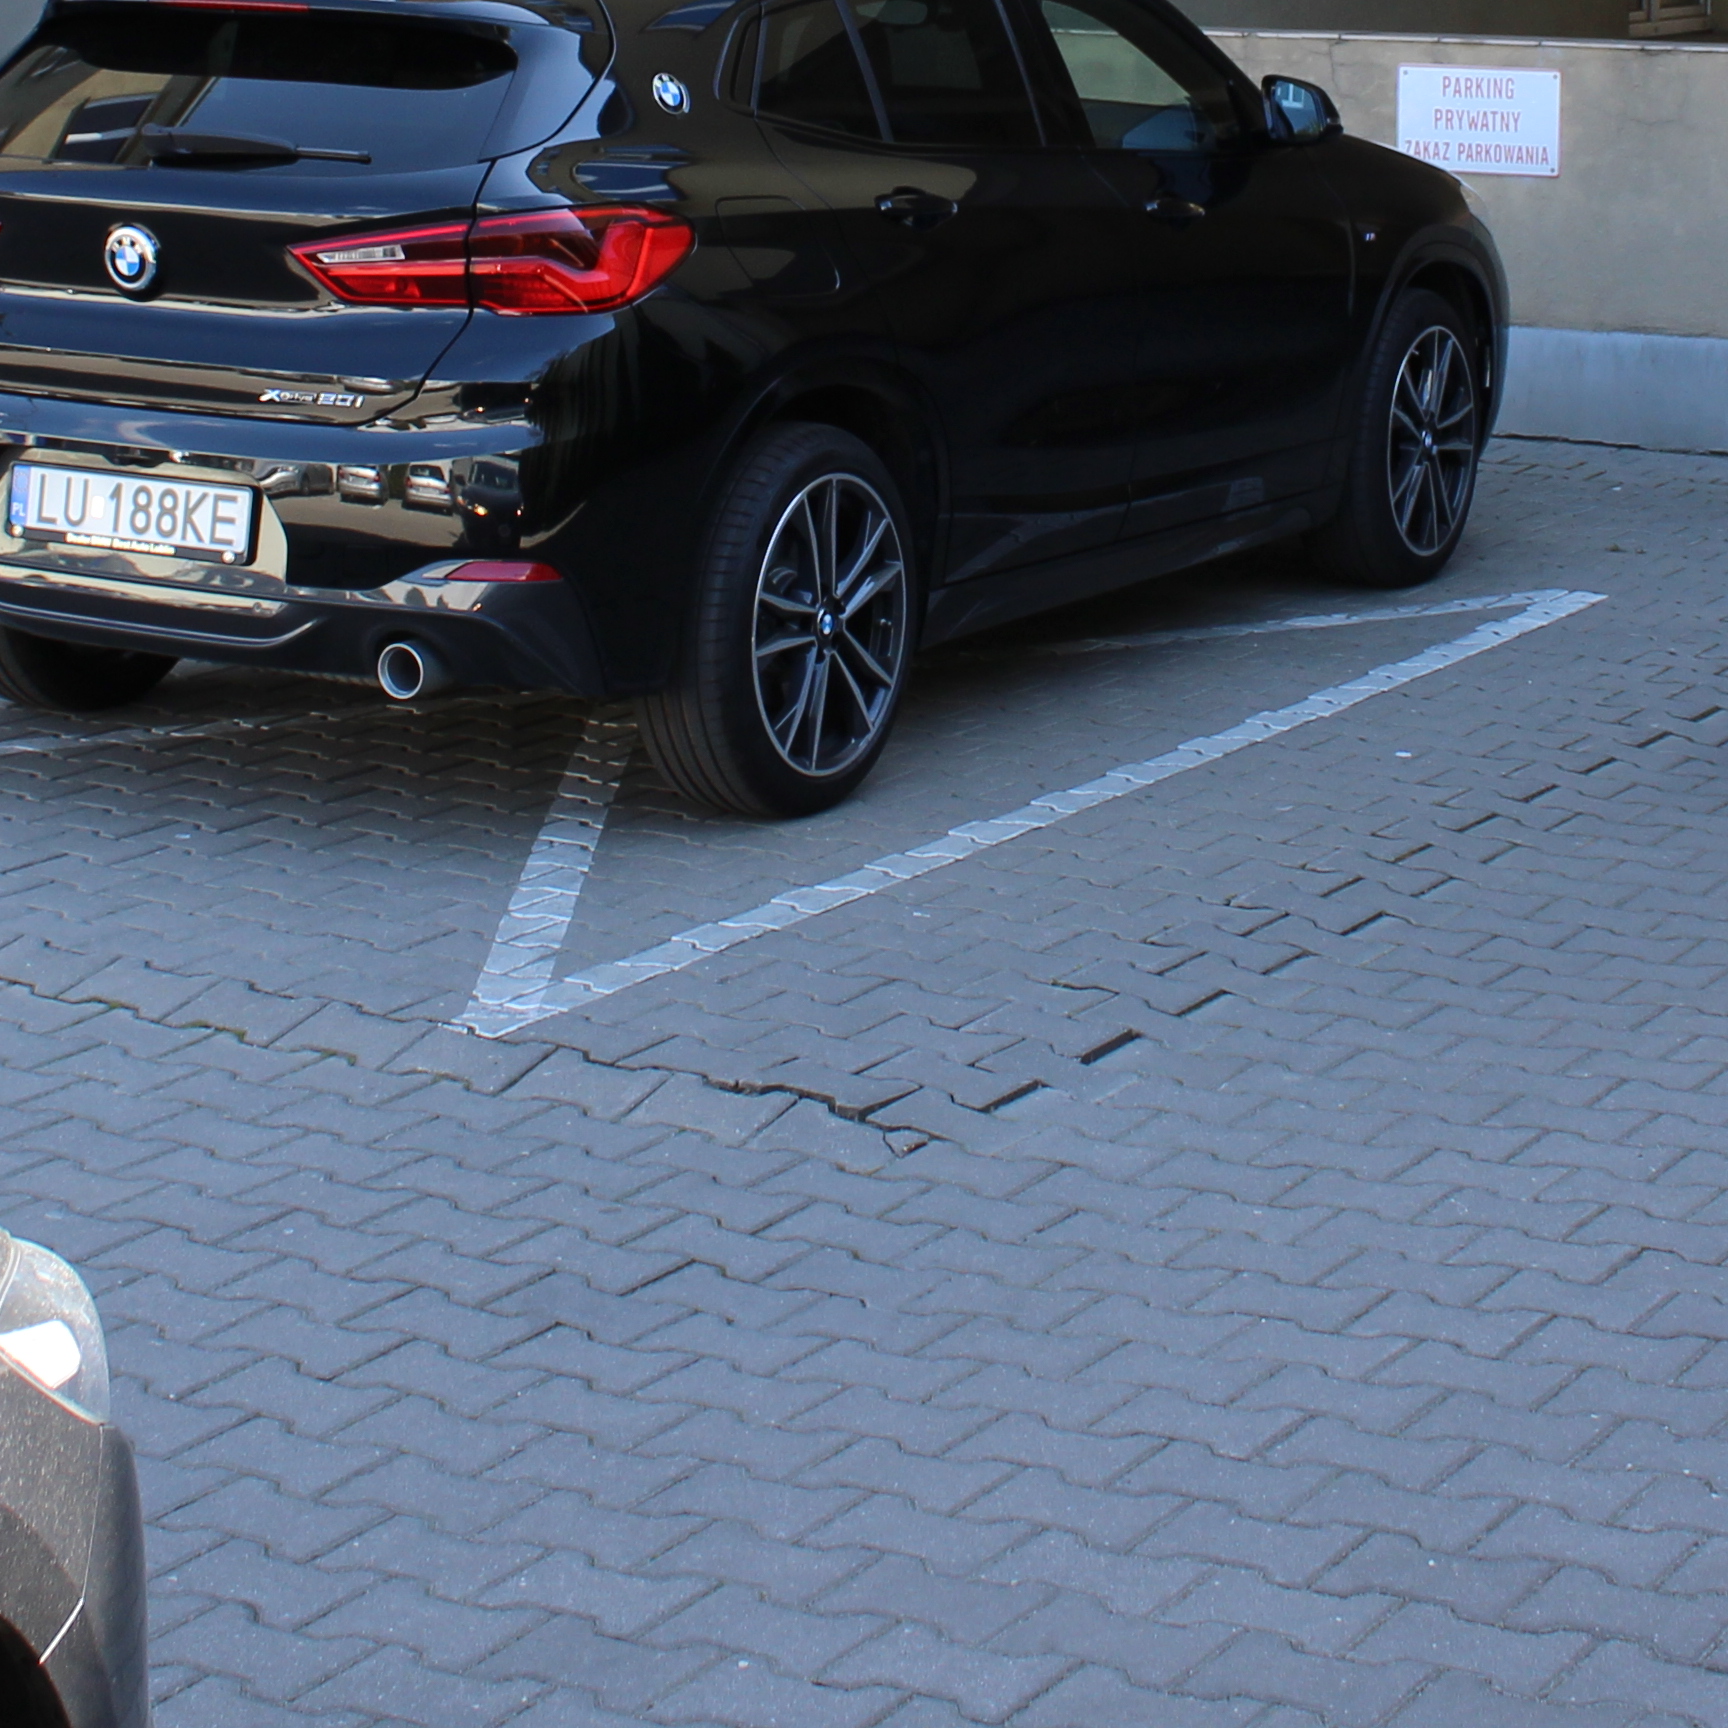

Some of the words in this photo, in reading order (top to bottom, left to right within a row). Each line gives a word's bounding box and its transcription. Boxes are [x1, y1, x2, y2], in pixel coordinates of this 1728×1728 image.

[1442, 75, 1516, 100] PARKING
[1433, 108, 1522, 133] PRYWATNY
[1404, 139, 1451, 162] ZAKAZ
[1457, 142, 1550, 166] PARKOWANIA
[11, 502, 26, 517] PL
[36, 473, 90, 527] LU
[108, 481, 240, 547] 188KE
